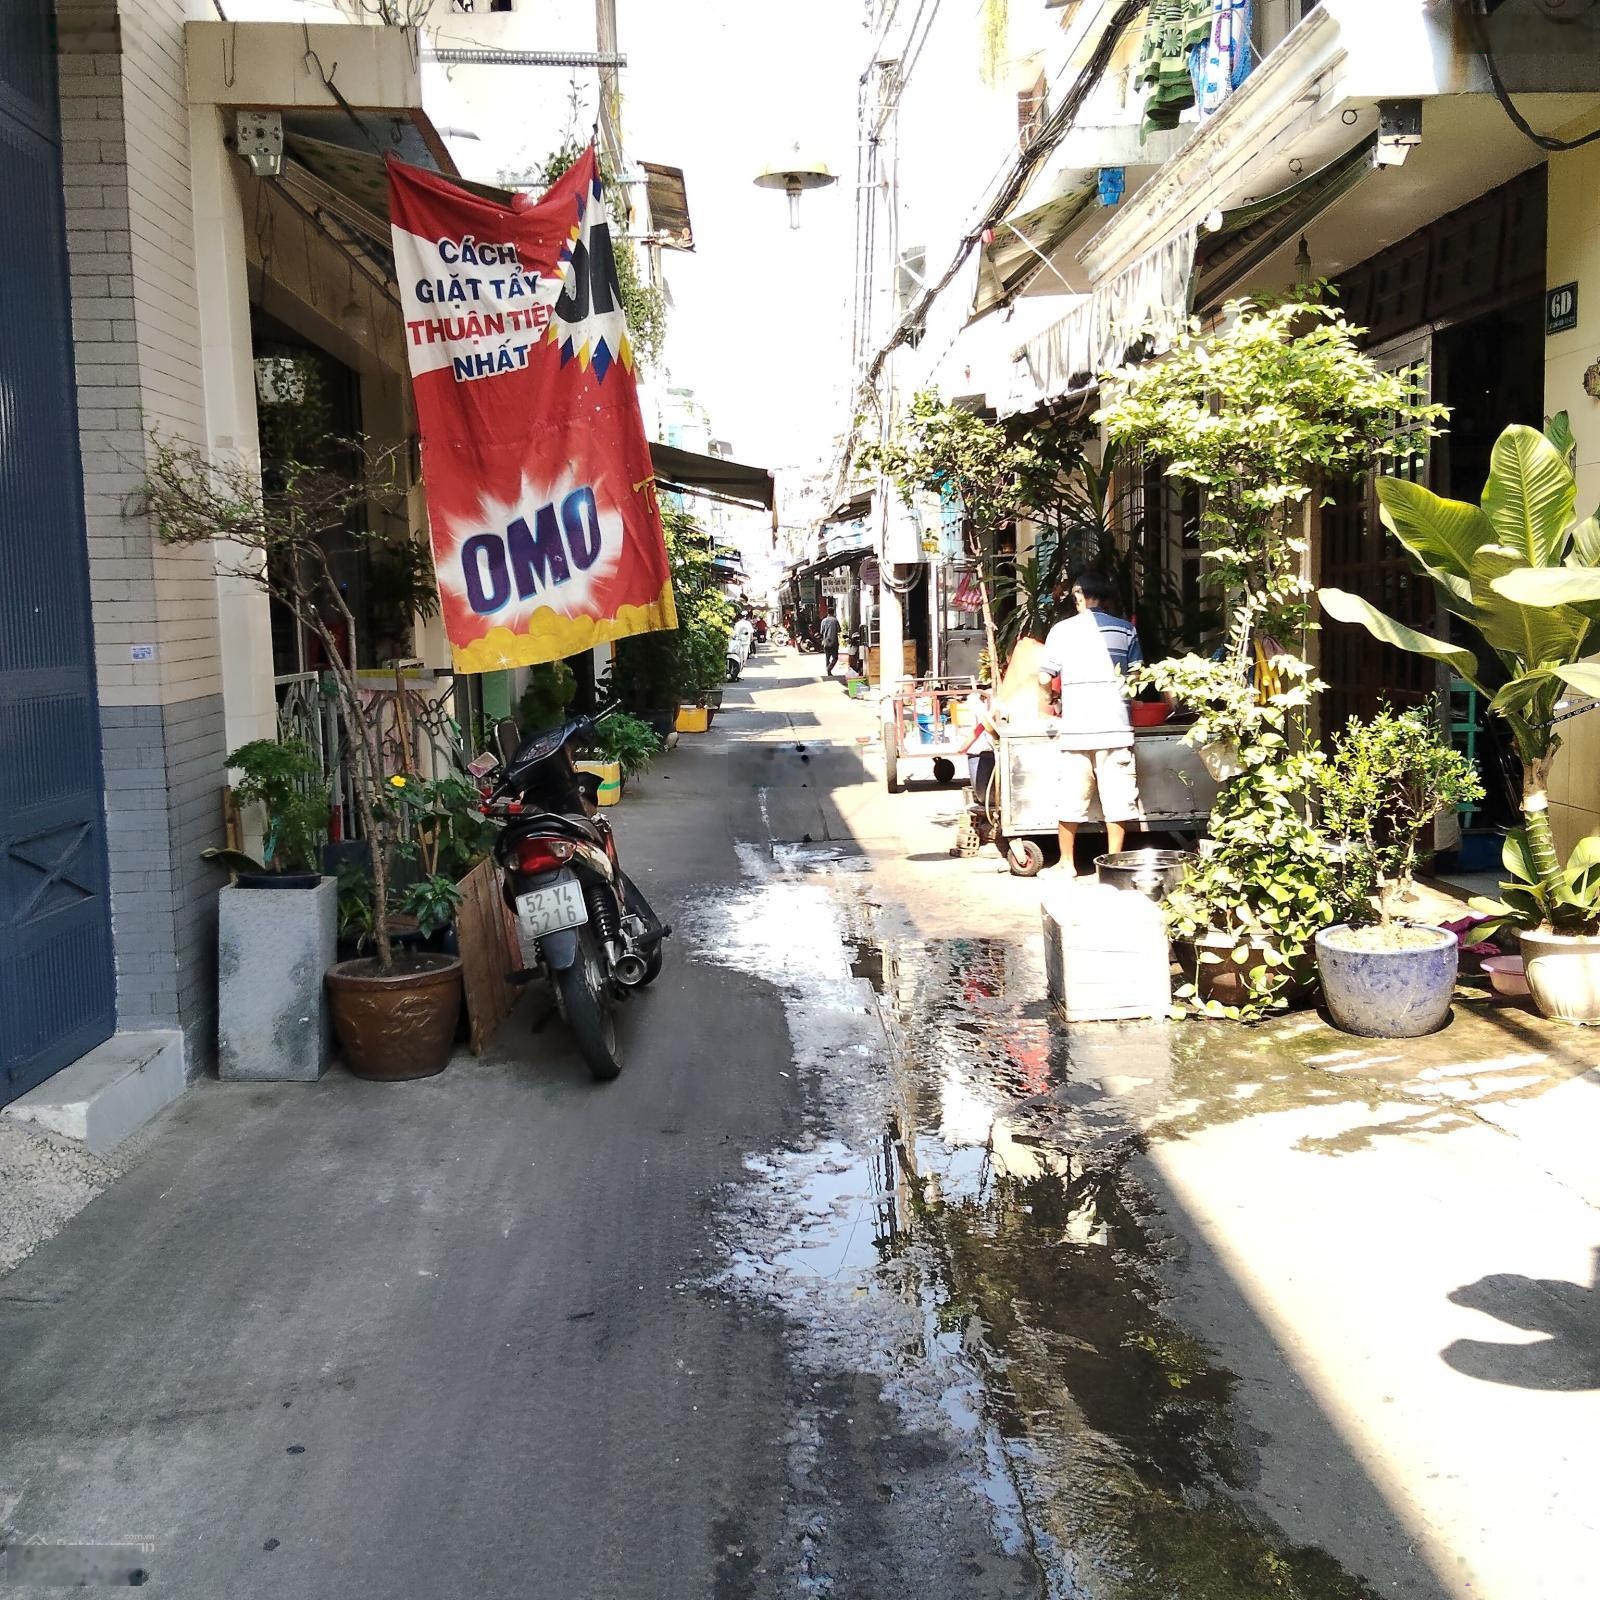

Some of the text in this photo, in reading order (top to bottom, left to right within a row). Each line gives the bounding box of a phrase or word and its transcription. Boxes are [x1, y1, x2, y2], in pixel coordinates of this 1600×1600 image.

[438, 235, 516, 265] CÁCH
[415, 266, 540, 308] GIẶT TẨY
[1551, 291, 1572, 318] 6D
[407, 309, 504, 345] THUẬN
[453, 339, 529, 379] NHẤT
[462, 486, 601, 615] OMO
[530, 905, 576, 934] 5216
